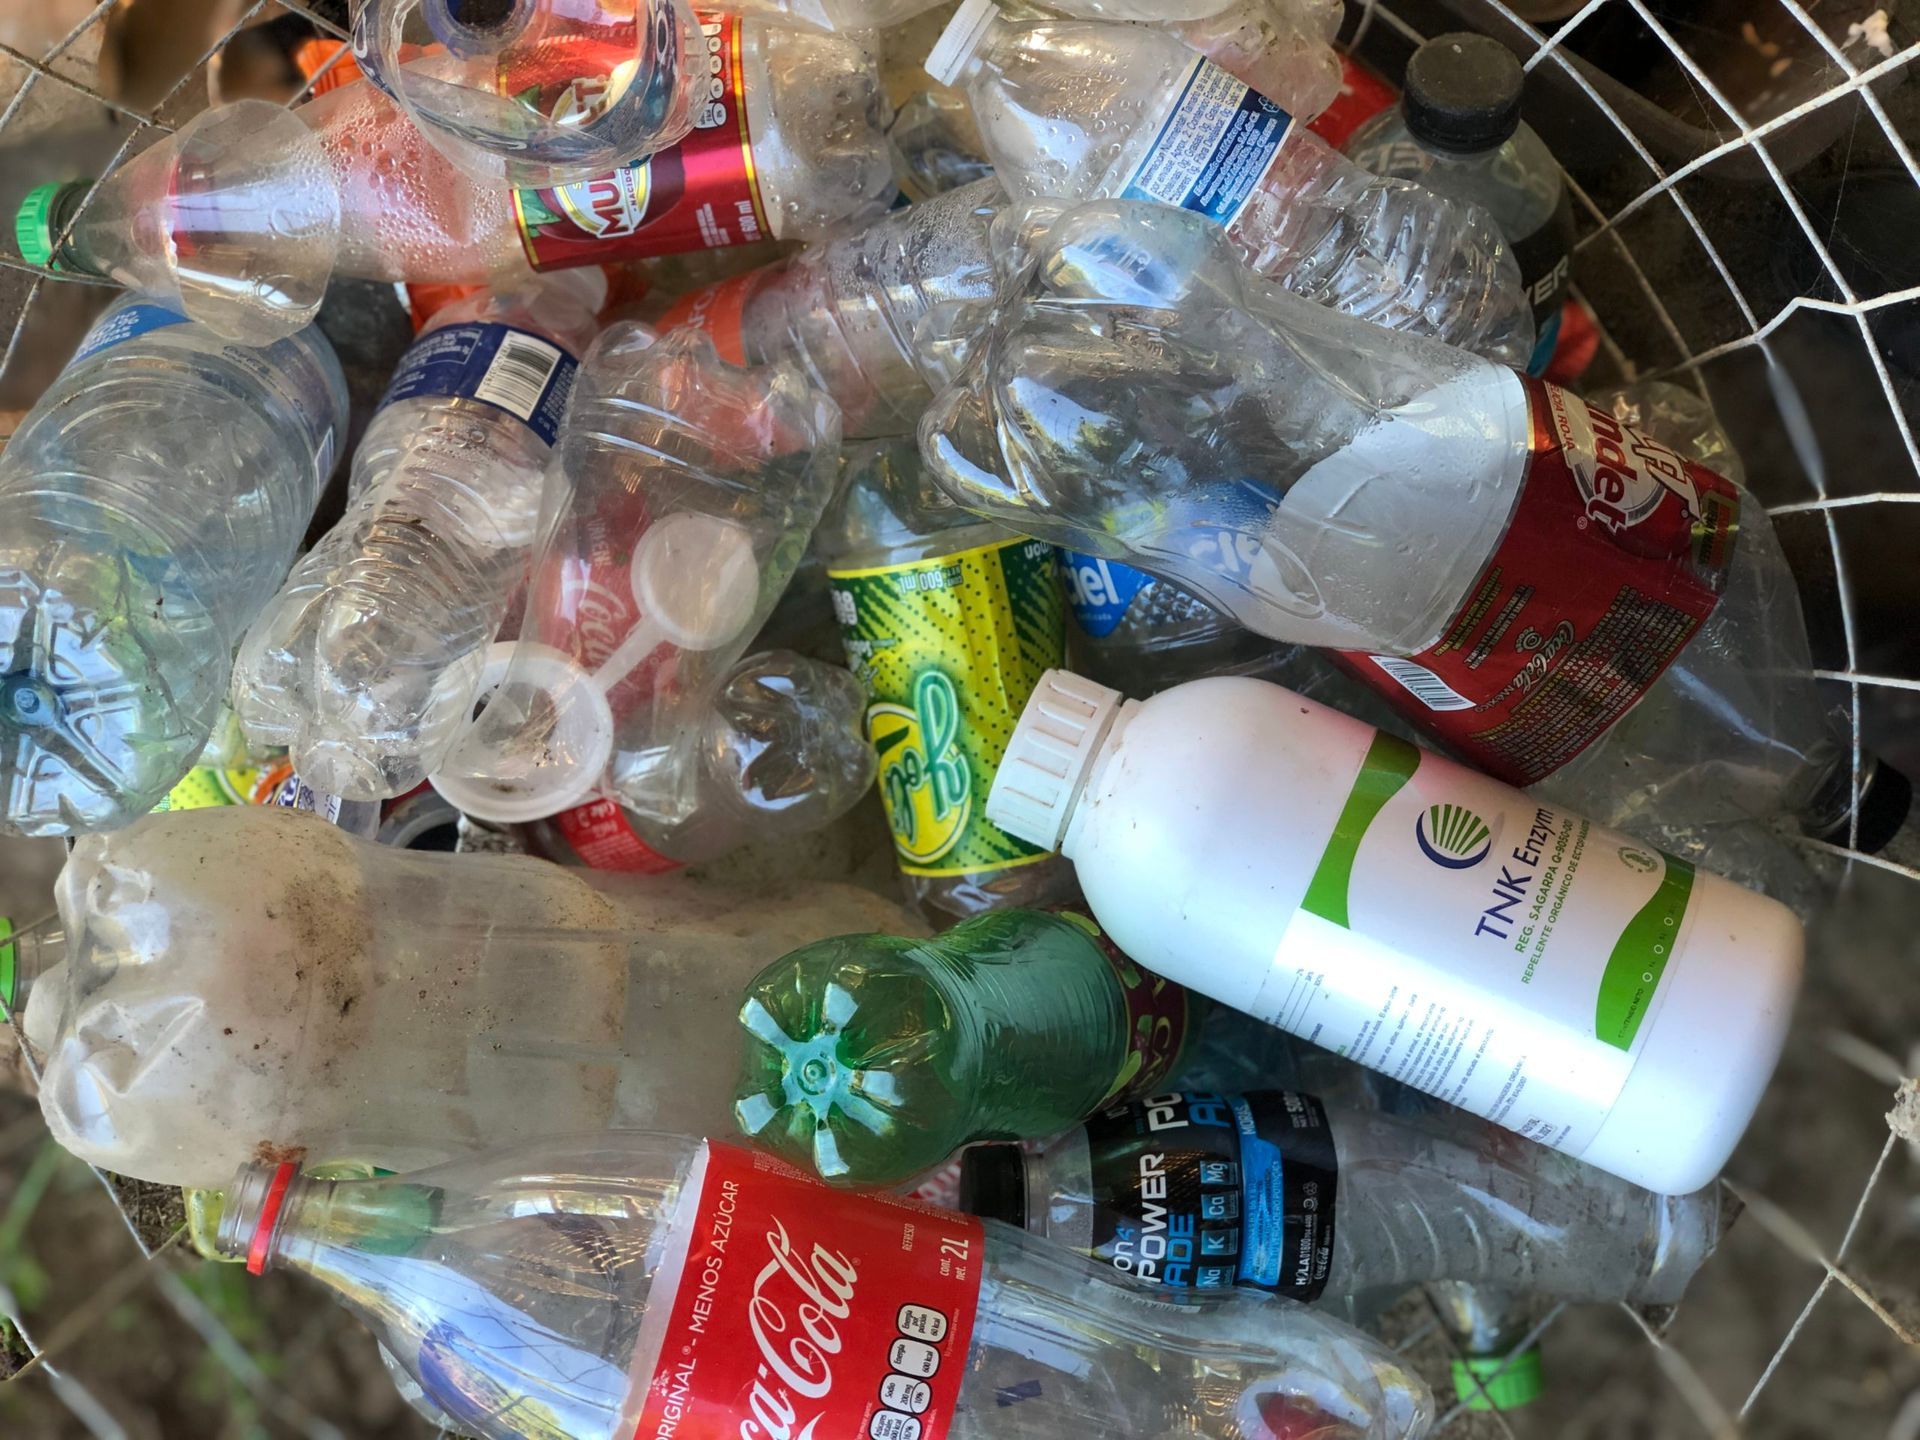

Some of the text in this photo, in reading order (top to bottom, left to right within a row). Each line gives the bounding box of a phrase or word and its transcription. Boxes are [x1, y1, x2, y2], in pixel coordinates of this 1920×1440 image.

[1558, 415, 1575, 450] ROJA
[918, 570, 943, 589] 600
[1513, 619, 1574, 693] Coca-Cola
[1473, 863, 1532, 939] TNK
[1512, 806, 1556, 867] Enzym
[1514, 920, 1535, 953] REG.
[1528, 864, 1559, 921] SAGARPA
[1521, 924, 1553, 984] REPELENTE
[1546, 872, 1574, 924] ORGÁNICO
[1567, 860, 1578, 873] DE
[1207, 1163, 1227, 1181] Mg
[1137, 1152, 1167, 1282] POWER
[1209, 1195, 1224, 1215] Ca
[901, 1222, 915, 1252] REFRESCO
[1165, 1212, 1195, 1286] ADE
[1207, 1234, 1225, 1249] K
[940, 1238, 969, 1277] cont. 2L
[1203, 1268, 1221, 1285] Na
[655, 1179, 740, 1440] ORIGINAL MENOS AZÚCAR
[740, 1214, 859, 1440] ca-Cola
[902, 1310, 913, 1329] Energía
[894, 1344, 906, 1364] Energía
[885, 1382, 896, 1398] Sodio
